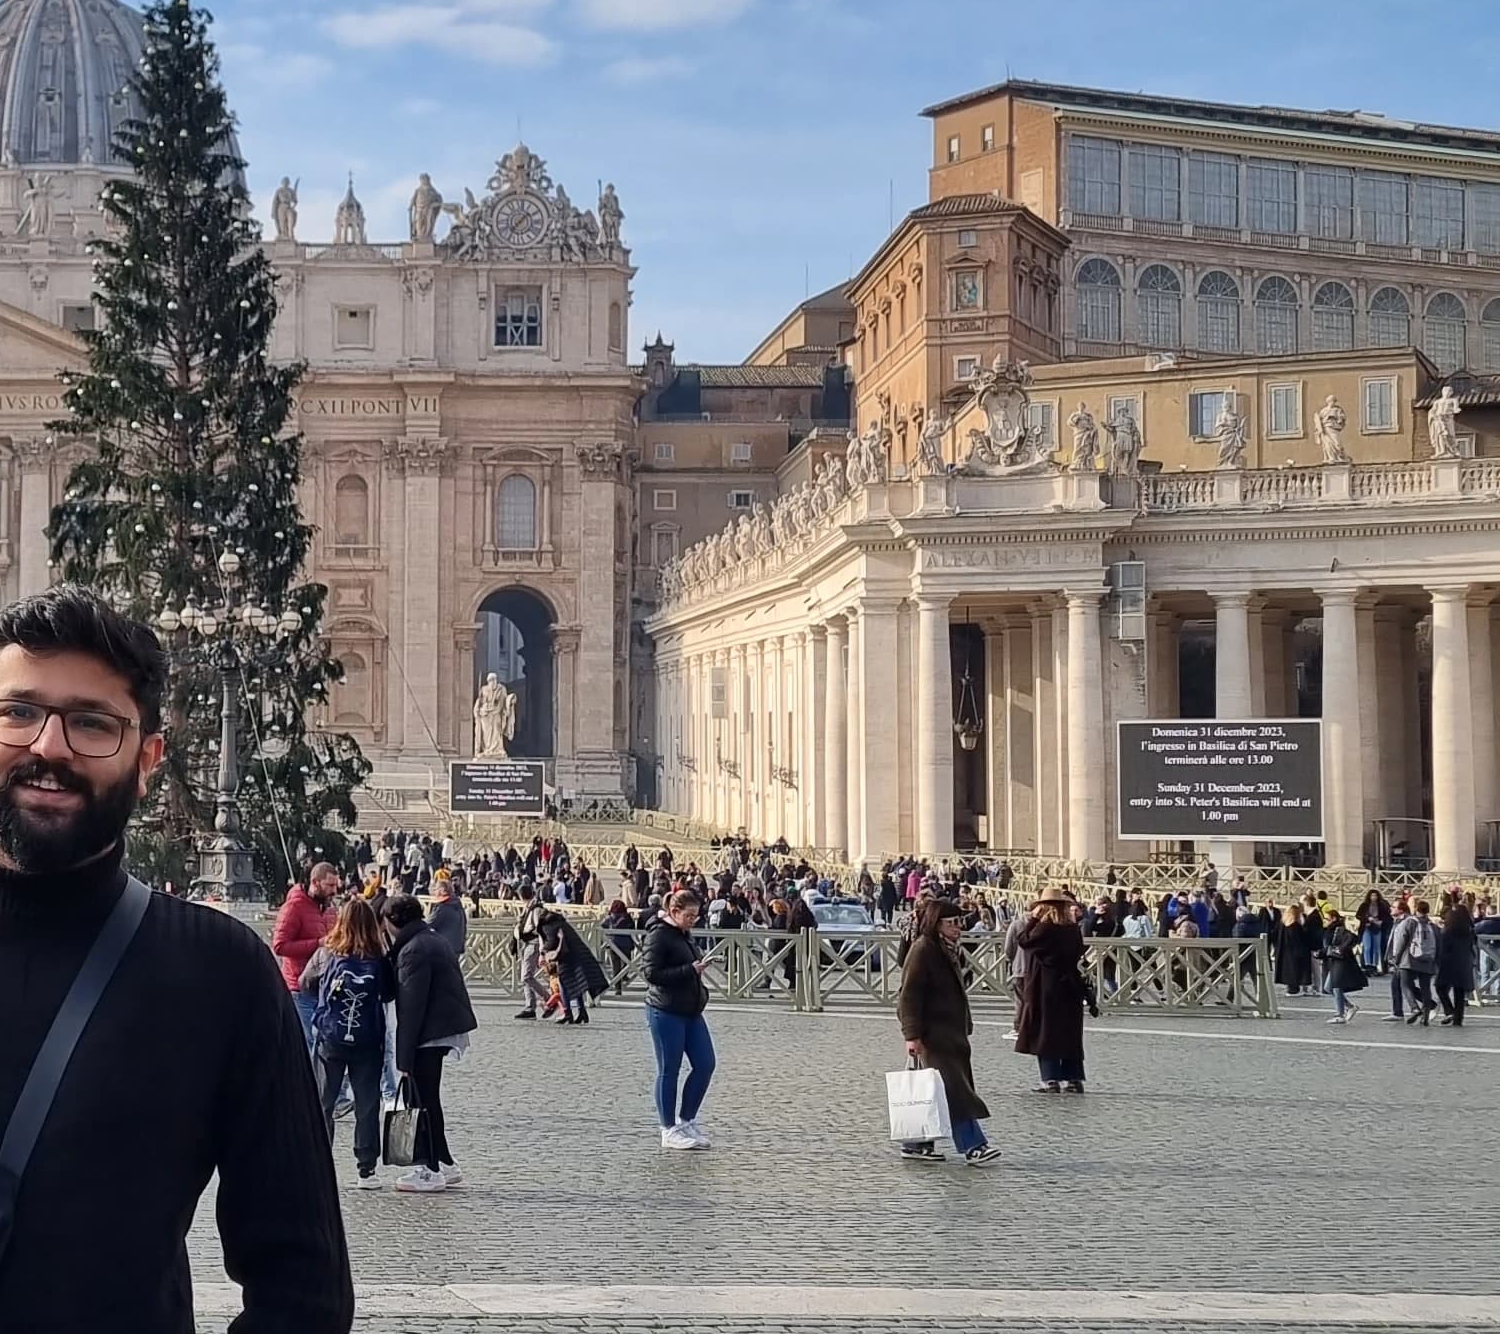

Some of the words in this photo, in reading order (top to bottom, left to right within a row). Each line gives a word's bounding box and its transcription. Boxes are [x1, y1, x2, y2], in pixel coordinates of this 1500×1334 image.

[33, 395, 59, 410] RO
[351, 399, 402, 414] PONT
[410, 397, 437, 413] VII
[1152, 726, 1199, 737] Domenica
[1200, 726, 1211, 737] 31
[1213, 726, 1258, 737] dicembre
[1187, 740, 1197, 751] in
[1199, 740, 1236, 751] Basilica
[1237, 740, 1248, 751] di
[1249, 740, 1268, 751] San
[1269, 740, 1299, 751] Pietro
[1209, 754, 1228, 765] alle
[1228, 757, 1245, 765] ore
[1247, 754, 1274, 765] 13.00
[1157, 782, 1192, 795] Sunday
[1193, 782, 1205, 793] 31
[1207, 782, 1256, 793] December
[1129, 797, 1154, 809] entry
[1155, 796, 1174, 806] into
[1174, 796, 1188, 807] St.
[1222, 796, 1260, 807] Basilica
[1261, 796, 1281, 807] will
[1281, 797, 1300, 807] end
[1301, 798, 1311, 808] at
[1202, 810, 1222, 821] 1.00
[1223, 813, 1239, 824] pm
